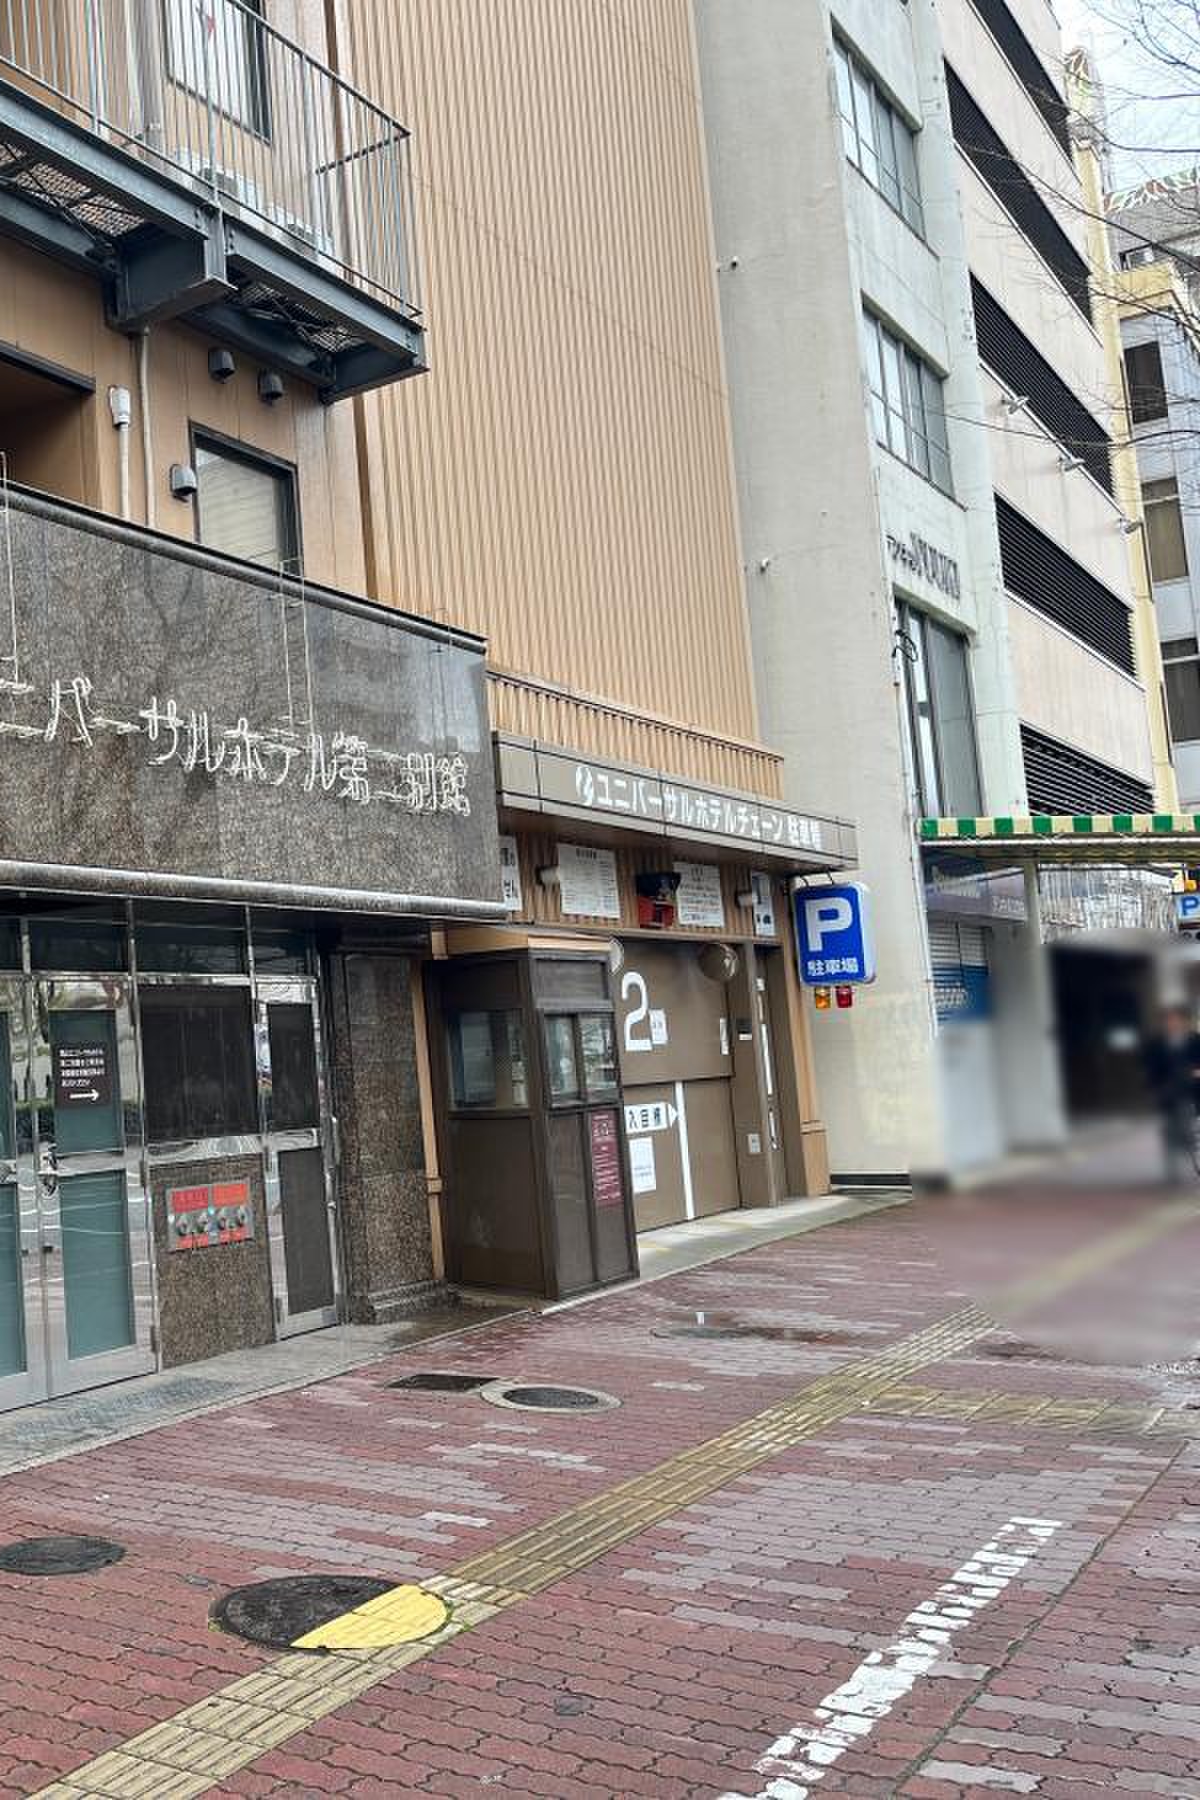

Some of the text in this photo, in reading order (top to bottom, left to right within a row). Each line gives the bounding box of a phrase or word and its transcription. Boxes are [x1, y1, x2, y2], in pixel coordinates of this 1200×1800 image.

[805, 897, 853, 952] P
[807, 957, 859, 977] 駐車場
[621, 971, 653, 1051] 2
